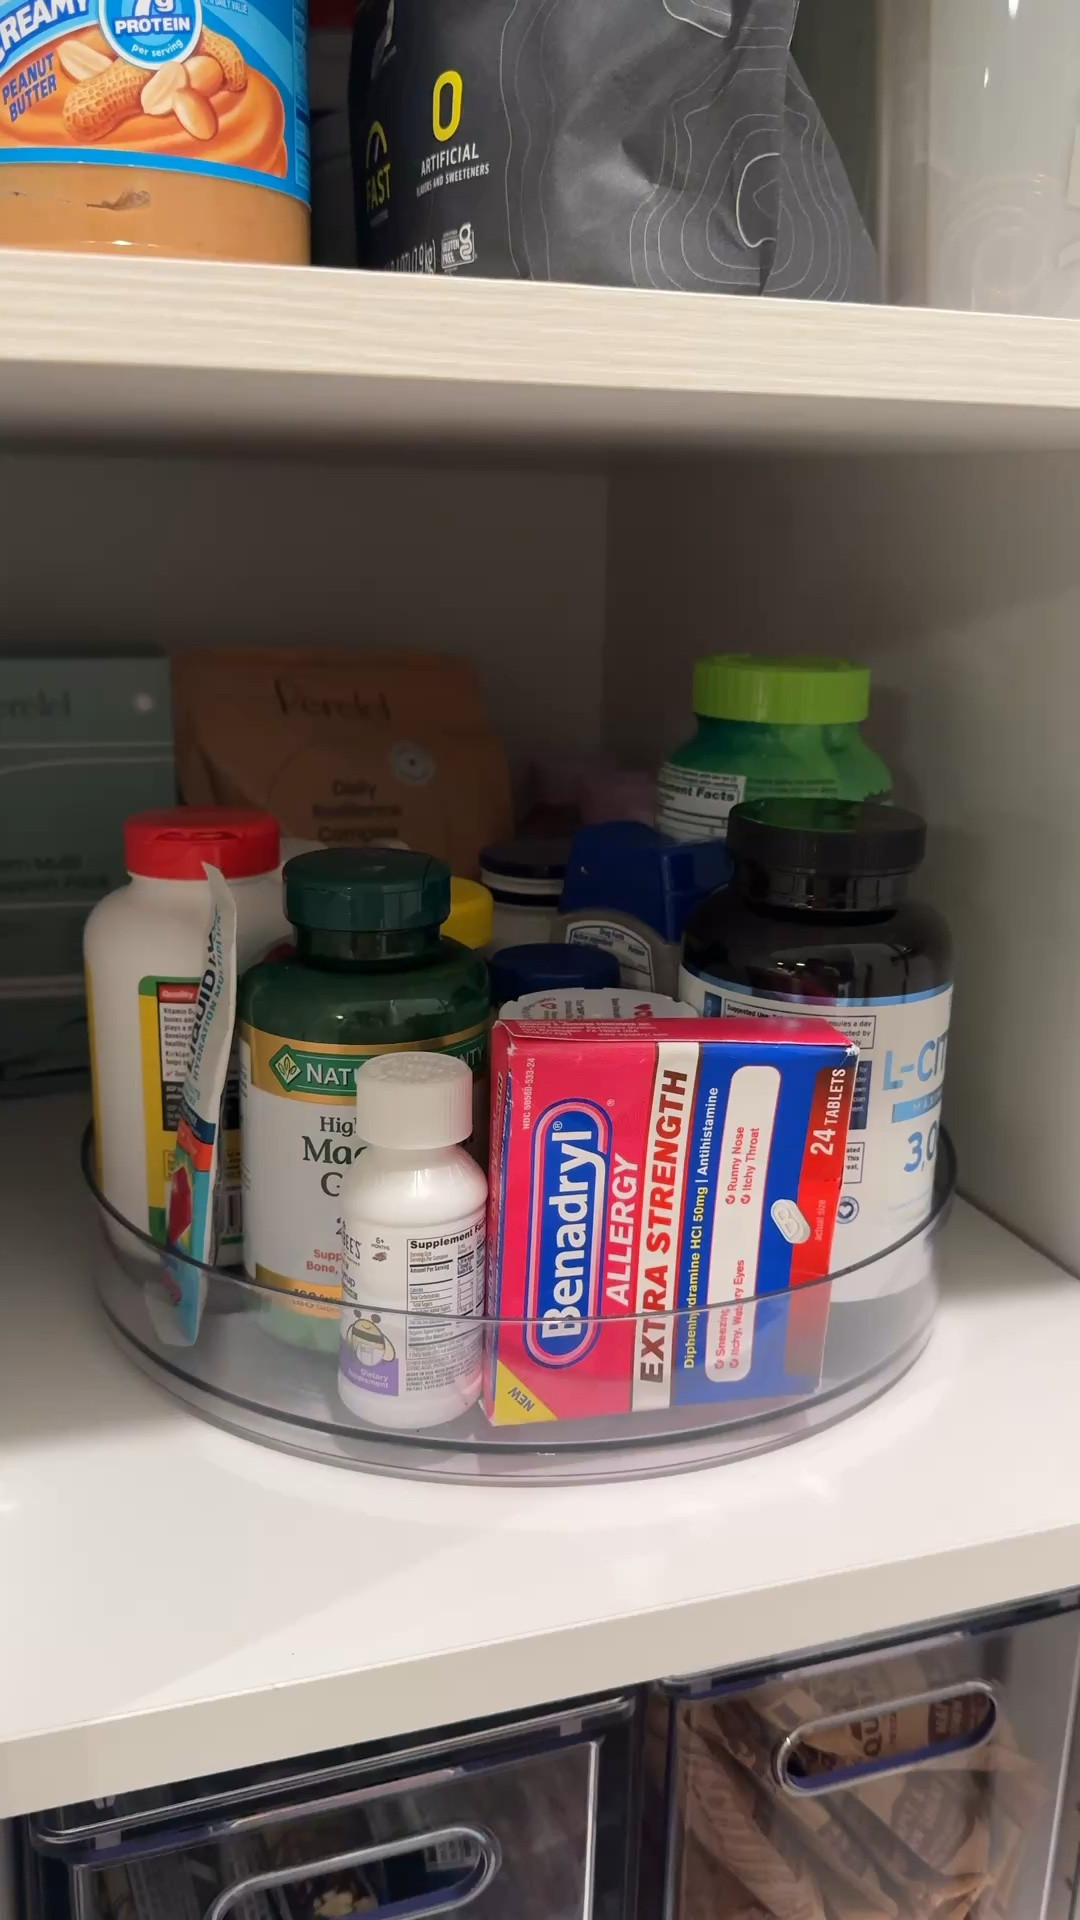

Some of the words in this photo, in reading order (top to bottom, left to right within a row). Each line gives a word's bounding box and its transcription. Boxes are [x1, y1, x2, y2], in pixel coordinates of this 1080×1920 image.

[0, 0, 88, 62] REAM
[114, 17, 191, 35] PROTEIN
[131, 43, 150, 56] per
[151, 38, 184, 58] serving
[2, 52, 54, 106] PEANUT
[9, 74, 57, 123] BUTTER
[432, 70, 464, 142] 0
[420, 142, 480, 178] ARTIFICIAL
[433, 174, 444, 189] AND
[445, 163, 490, 185] SWEETENERS
[442, 251, 456, 266] FREE
[695, 787, 736, 802] Facts
[162, 989, 194, 1000] Quality
[163, 1007, 187, 1015] Vitamin
[187, 969, 217, 1074] LIQUID
[726, 1003, 756, 1017] Suggested
[860, 1020, 872, 1029] day
[862, 1029, 872, 1038] by
[165, 1049, 190, 1057] Kirklan
[193, 1001, 217, 1081] HYDRATION
[883, 1033, 949, 1091] L-CIT
[521, 1112, 532, 1130] NDC
[810, 1128, 836, 1156] 24
[823, 1068, 847, 1126] TABLETS
[696, 1086, 719, 1176] Antihistamine
[731, 1126, 745, 1155] Nose
[745, 1127, 760, 1163] Throat
[903, 1120, 938, 1173] 3,0
[646, 1069, 689, 1255] STRENGTH
[727, 1158, 742, 1192] Runny
[742, 1165, 756, 1192] Itchy
[692, 1186, 708, 1222] 50mg
[814, 1199, 827, 1219] size
[375, 1236, 385, 1245] 6+
[409, 1228, 473, 1250] Supplement
[541, 1130, 606, 1338] Benadryl
[605, 1152, 640, 1307] ALLERGY
[814, 1220, 826, 1242] actual
[306, 1260, 338, 1275] Bone,
[313, 1248, 343, 1263] Supp
[733, 1259, 746, 1285] Eyes
[732, 1287, 745, 1325] Watry
[640, 1264, 669, 1384] EXTRA
[715, 1308, 730, 1358] Sneezing
[360, 1367, 389, 1382] Dietary
[507, 1386, 535, 1412] NEW
